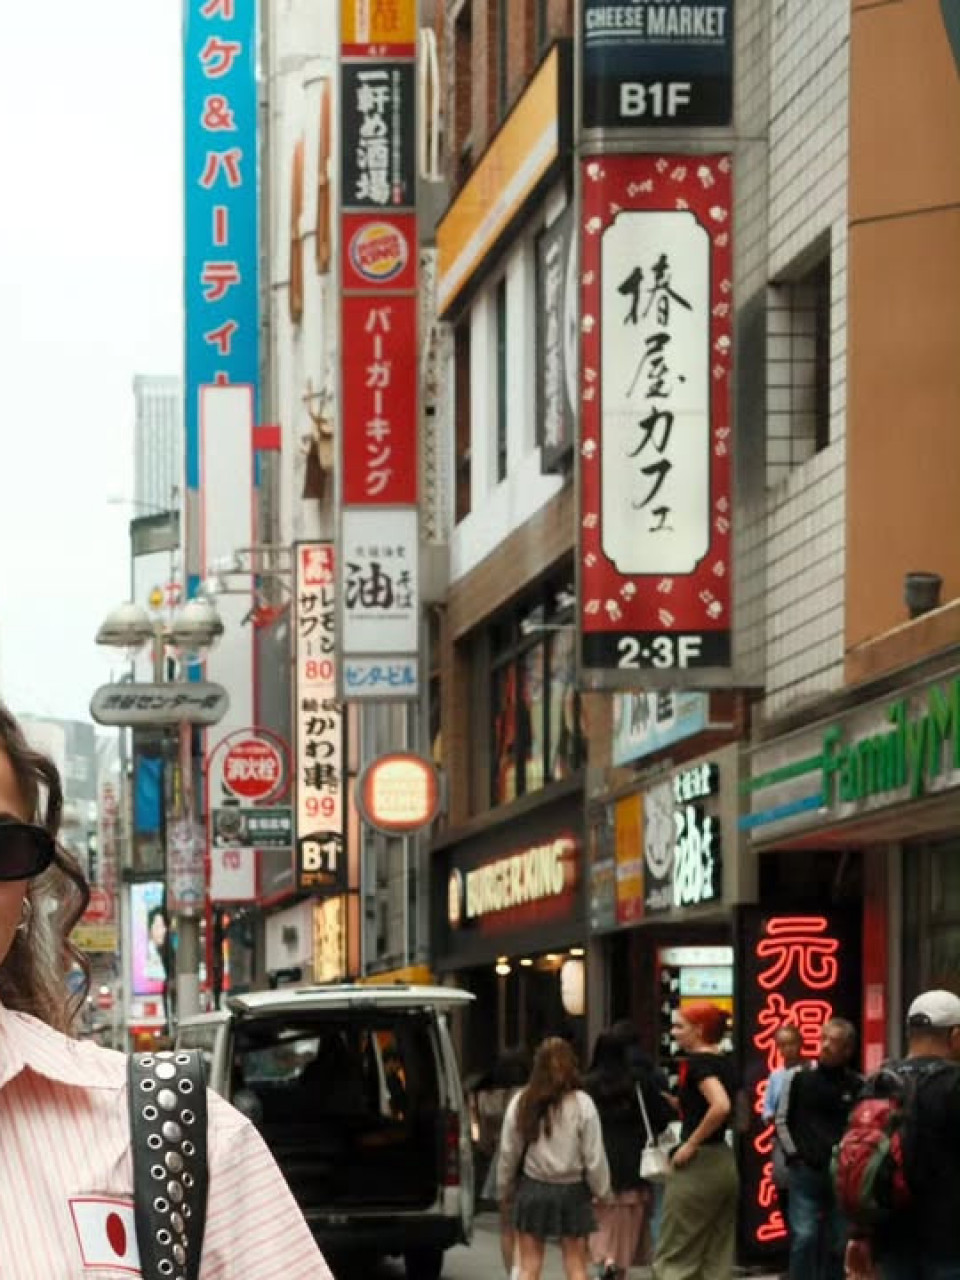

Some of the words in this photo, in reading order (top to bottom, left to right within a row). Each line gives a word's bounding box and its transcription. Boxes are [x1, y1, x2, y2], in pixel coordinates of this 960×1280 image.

[586, 7, 644, 30] CHEESE
[647, 5, 726, 36] MARKET
[619, 82, 692, 118] B1F
[365, 306, 392, 496] バーガーキング
[617, 253, 693, 534] 椿屋カフェ
[305, 660, 334, 680] 80
